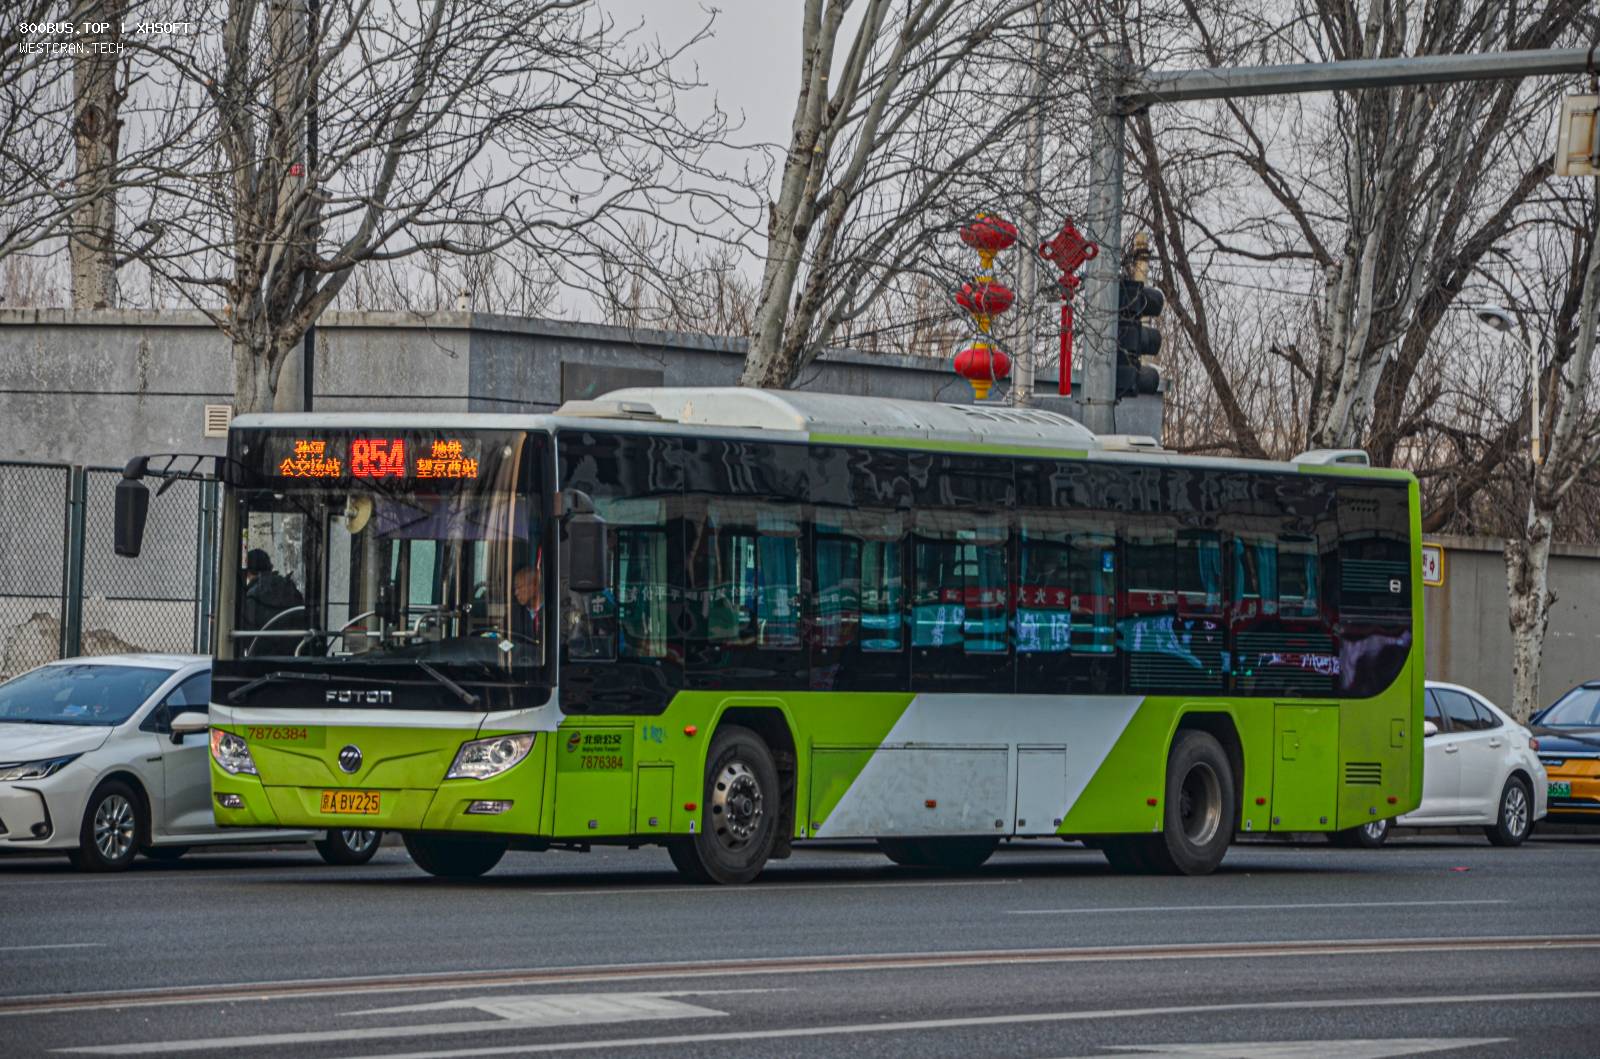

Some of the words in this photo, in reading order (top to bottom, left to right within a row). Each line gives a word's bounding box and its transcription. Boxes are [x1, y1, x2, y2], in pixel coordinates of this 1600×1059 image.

[351, 439, 405, 478] 854
[280, 458, 341, 477] 公交场站
[416, 458, 478, 478] 望京西站
[325, 690, 393, 704] FOTON
[247, 727, 307, 740] 7876384
[584, 734, 622, 745] 北京公交
[580, 755, 623, 769] 7876384
